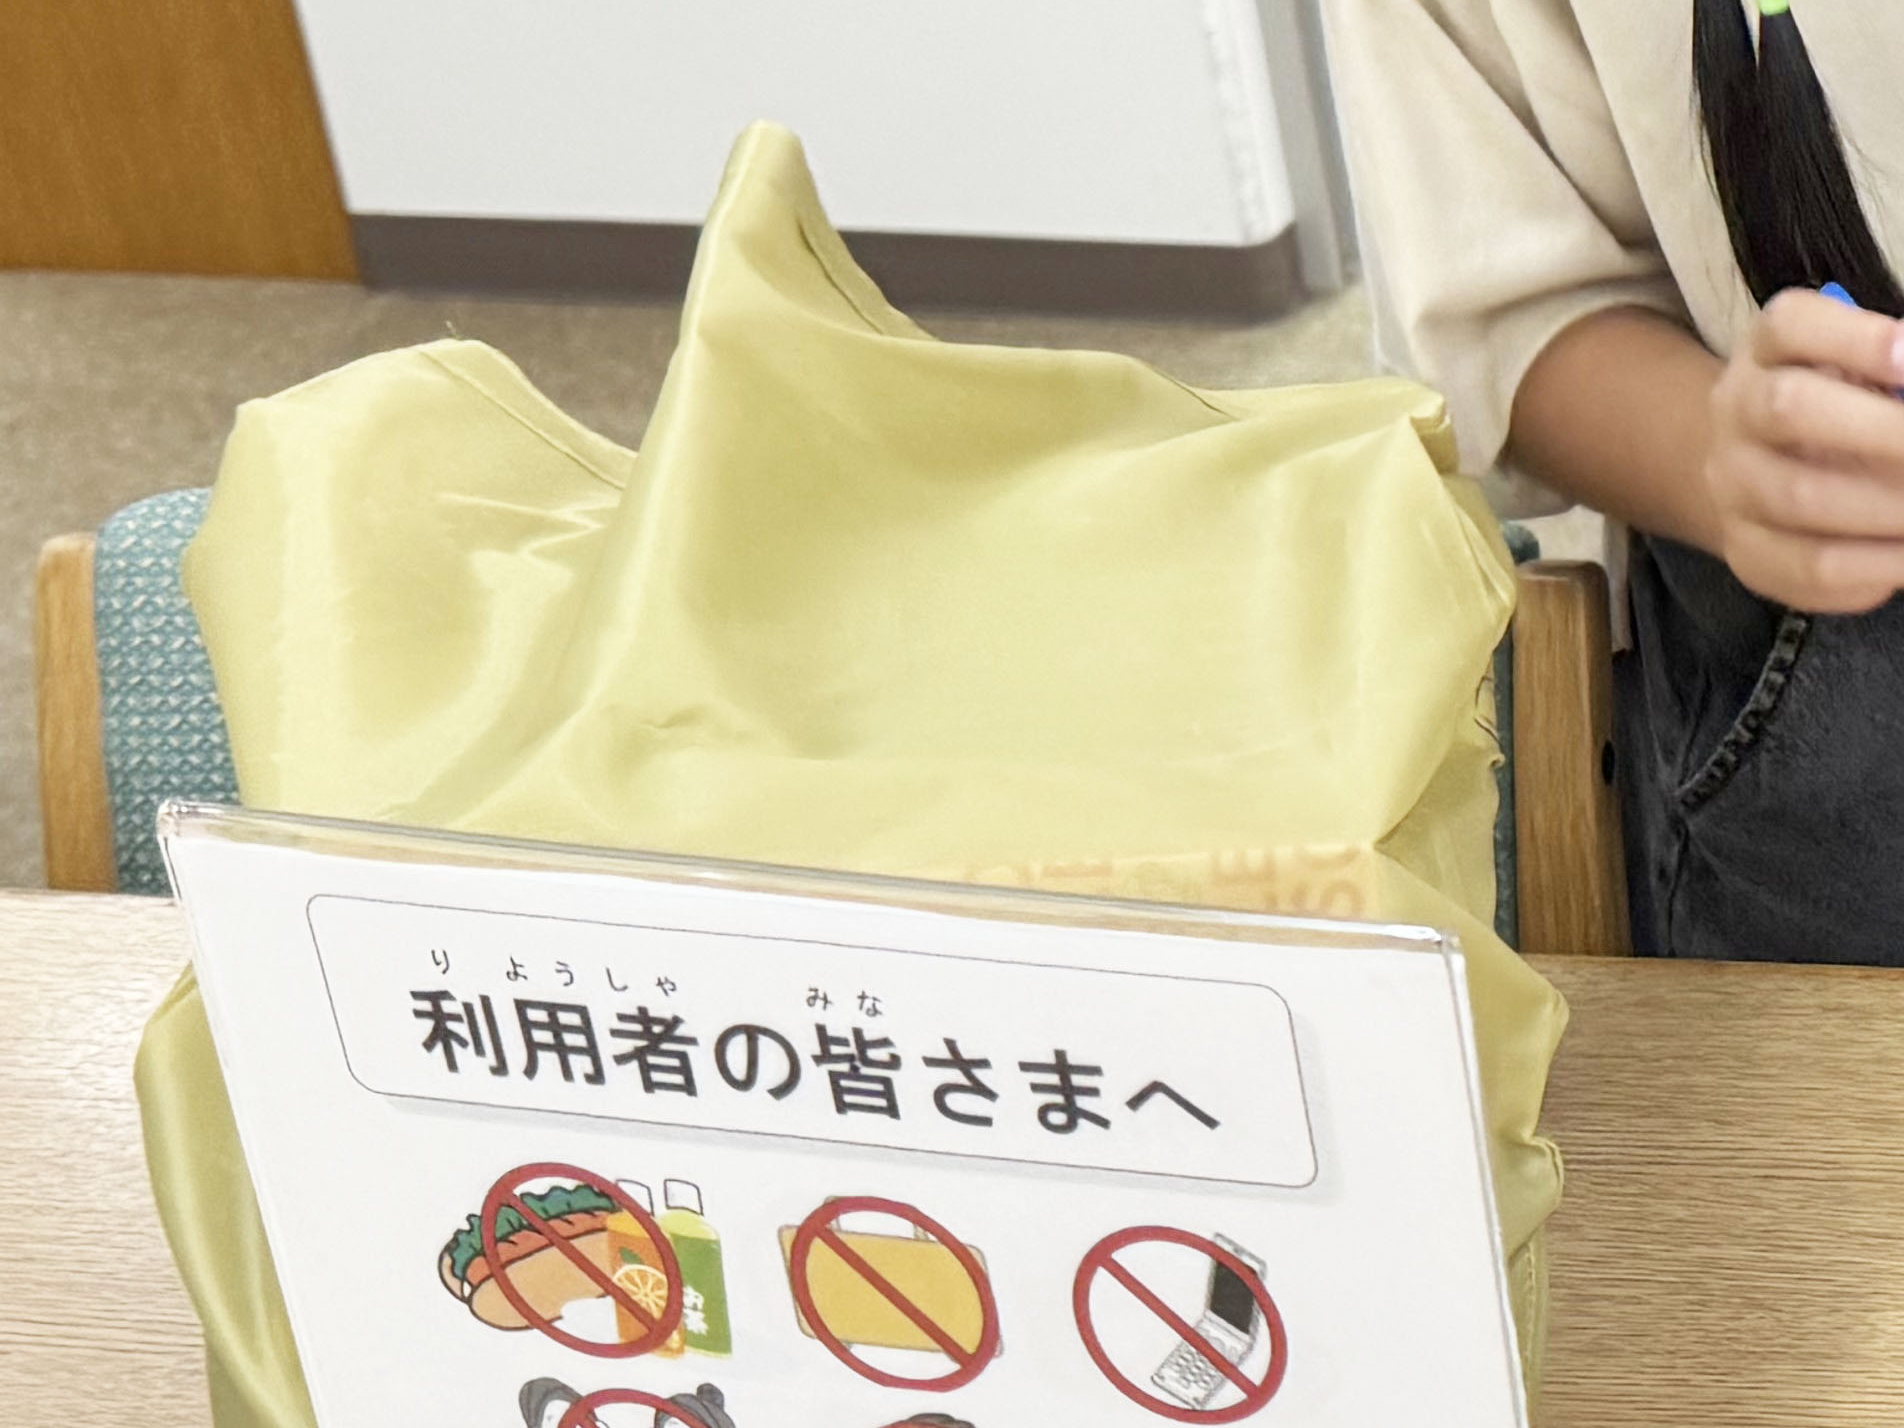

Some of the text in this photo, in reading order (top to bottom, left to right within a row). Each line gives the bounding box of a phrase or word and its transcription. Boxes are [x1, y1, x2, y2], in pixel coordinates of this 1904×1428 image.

[431, 949, 883, 1017] りようしゃ みな
[410, 988, 1219, 1136] 利用者の皆さまへ
